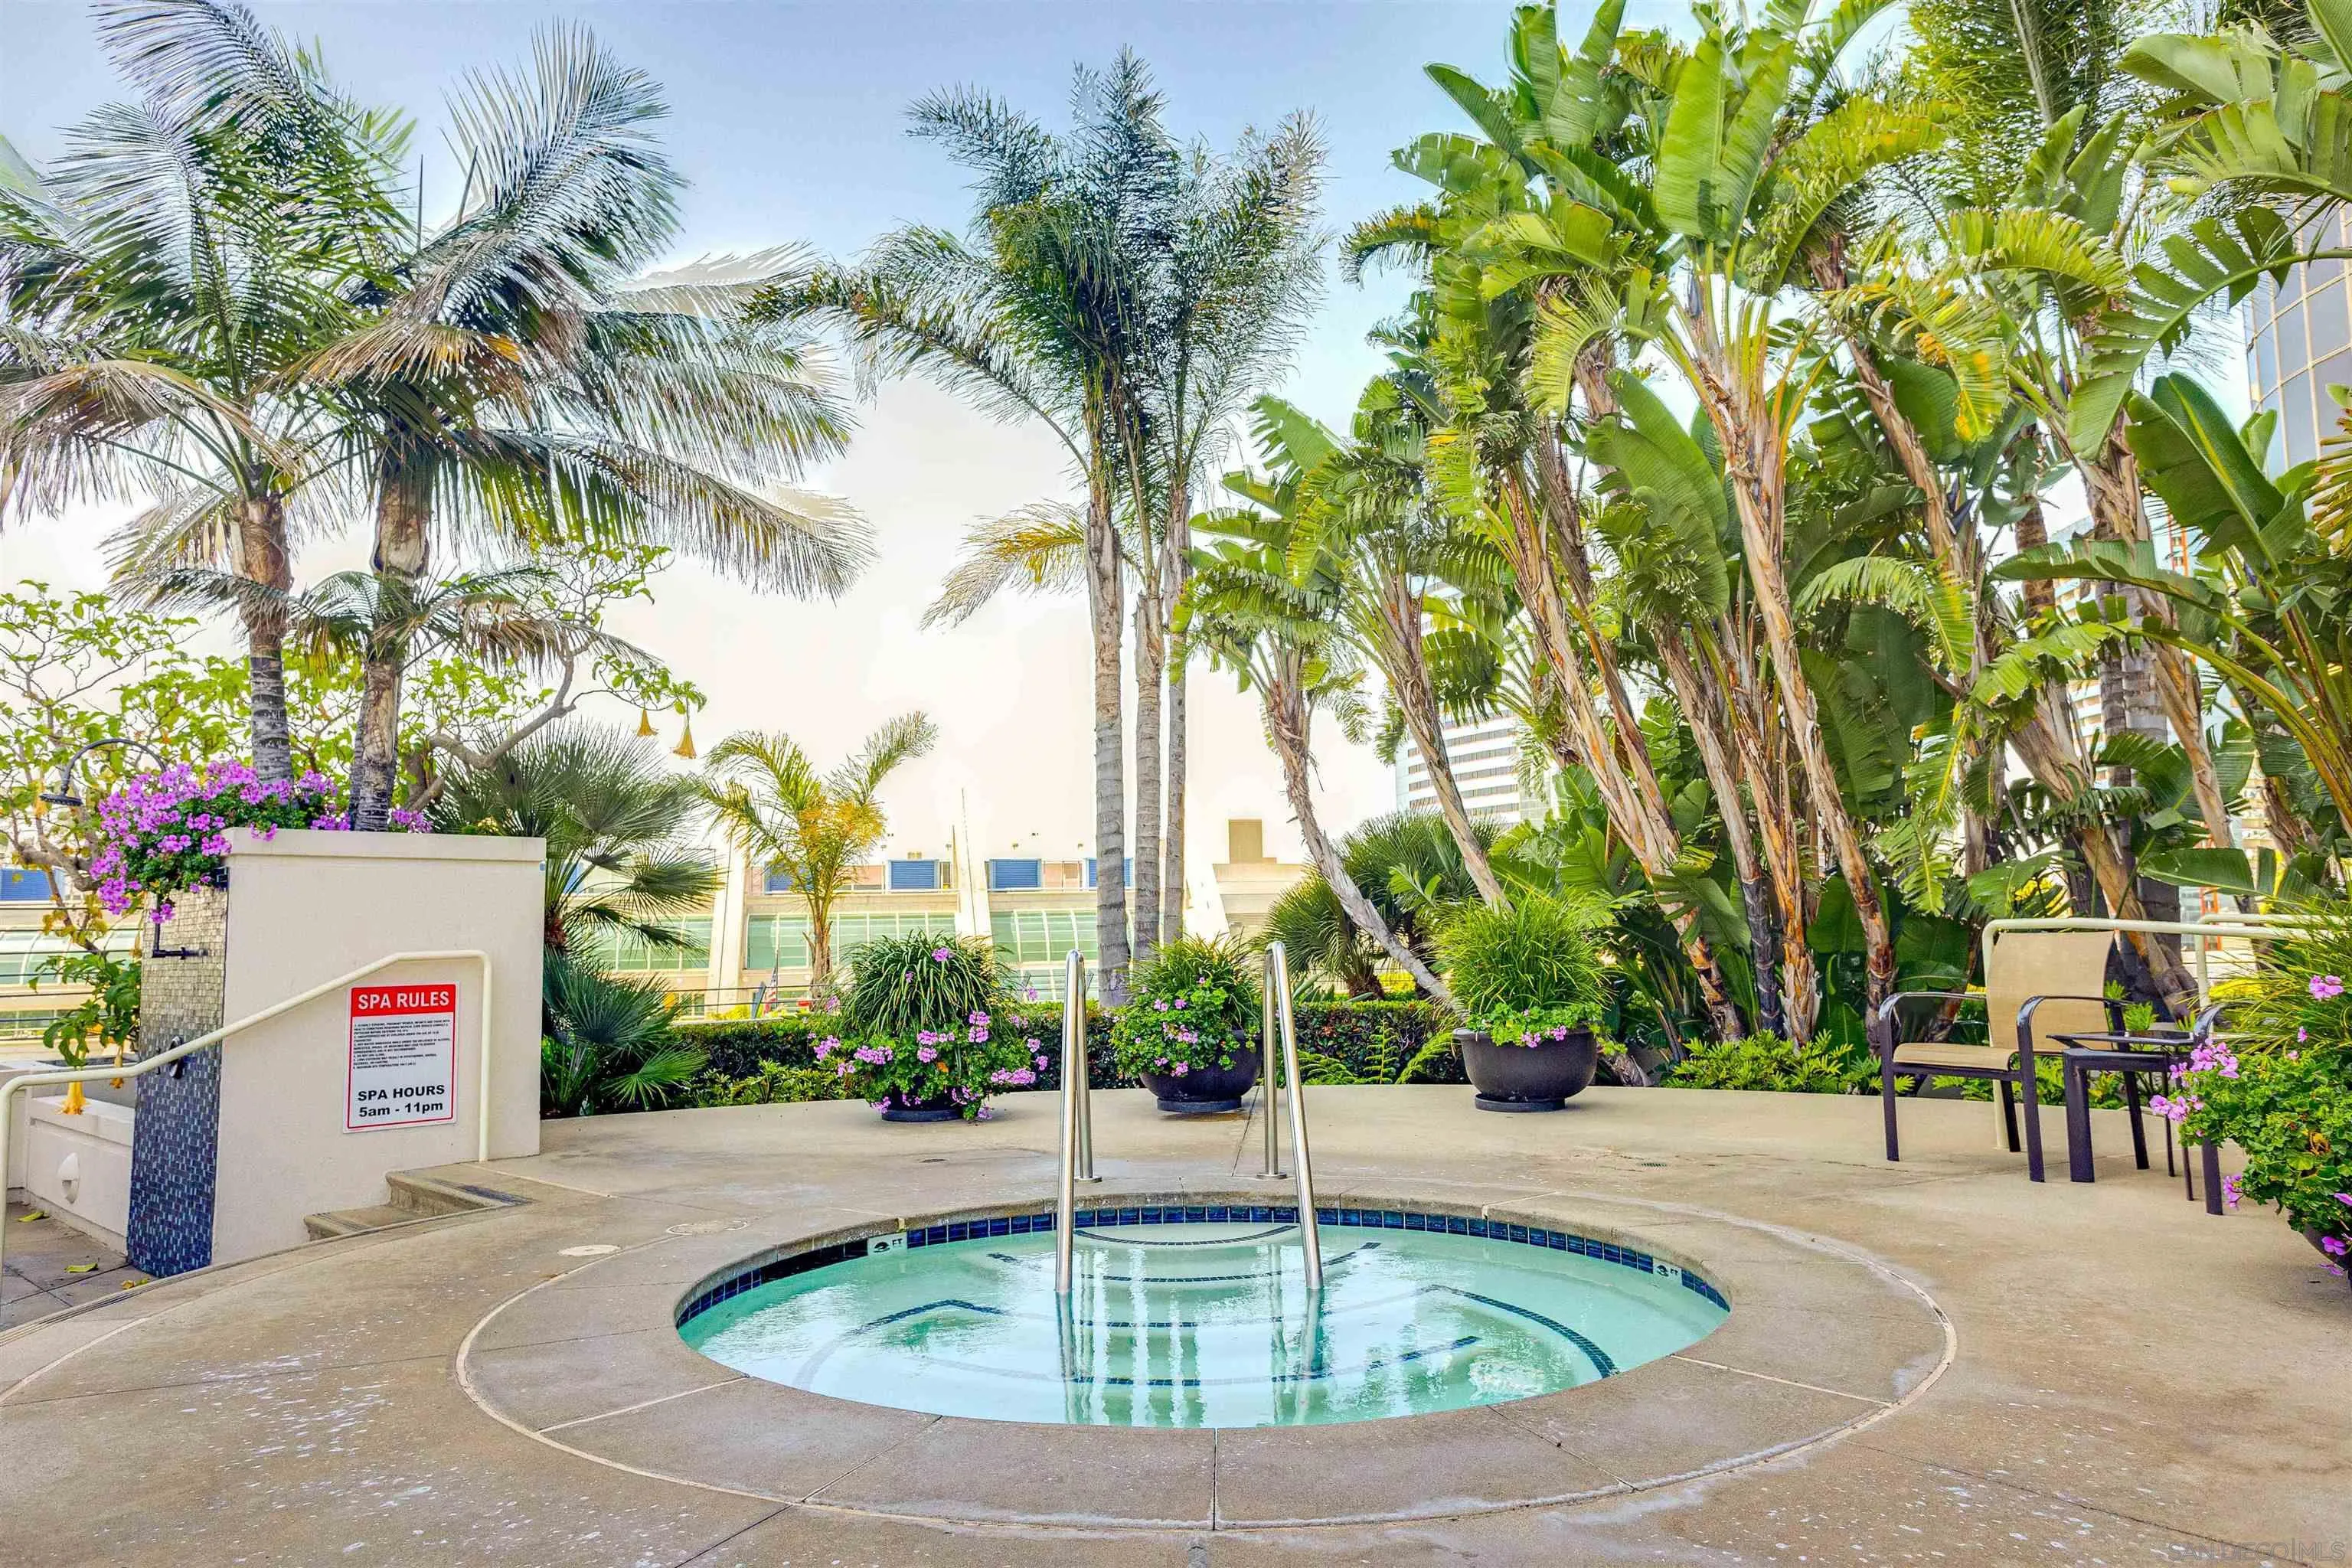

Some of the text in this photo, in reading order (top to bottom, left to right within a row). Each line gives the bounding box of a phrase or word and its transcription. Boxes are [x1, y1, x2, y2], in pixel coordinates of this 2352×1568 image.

[358, 991, 450, 1010] SPA RULES
[358, 1084, 445, 1101] SPA HOURS
[359, 1106, 390, 1117] 5am
[404, 1102, 443, 1114] 11pm
[891, 1238, 903, 1246] FT
